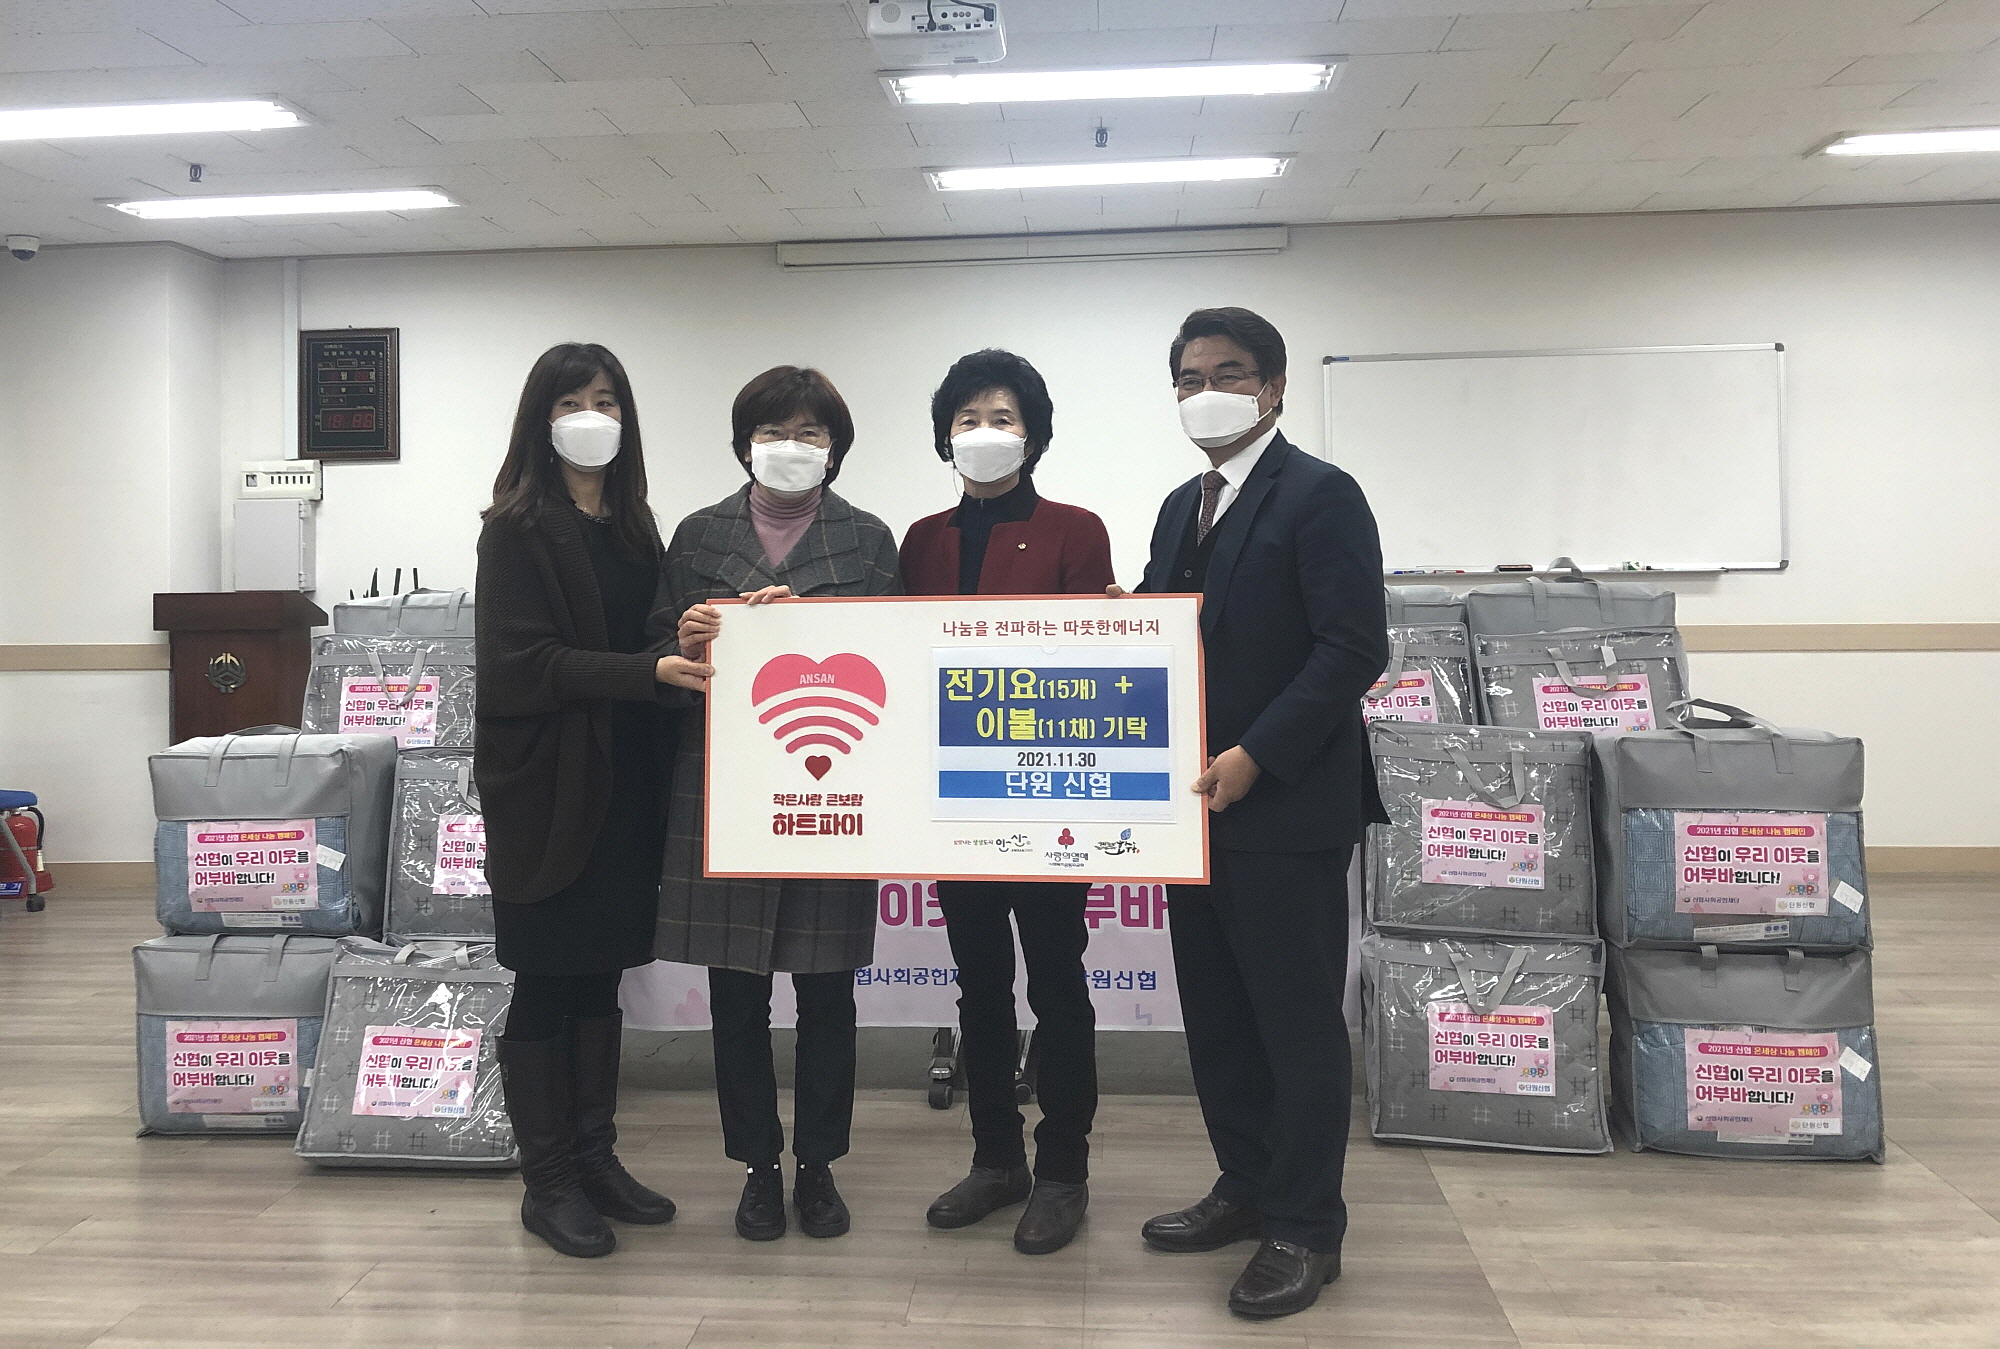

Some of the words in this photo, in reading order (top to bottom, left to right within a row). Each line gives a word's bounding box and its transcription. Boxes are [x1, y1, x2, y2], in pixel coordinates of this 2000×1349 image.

[943, 621, 989, 636] 나눔을
[995, 620, 1057, 636] 전파하는
[1063, 619, 1160, 636] 따뜻한에너지
[800, 673, 835, 684] ANSAN
[946, 669, 1097, 701] 전기요(15개)
[1114, 676, 1133, 694] +
[345, 700, 375, 711] 신협이
[1396, 695, 1430, 708] 이웃을
[1542, 700, 1578, 713] 신협이
[1581, 699, 1607, 712] 우리
[1610, 698, 1648, 710] 이웃을
[344, 715, 406, 727] 어부바합니다!
[976, 707, 1095, 740] 이불(11채)
[1103, 716, 1147, 740] 기탁
[1544, 716, 1618, 728] 어부바합니다!
[1017, 751, 1096, 767] 2021.11.30
[1005, 772, 1052, 797] 단원
[1063, 773, 1111, 798] 신협
[773, 793, 822, 806] 작은사랑
[827, 793, 863, 806] 큰보람
[1438, 810, 1459, 818] 2021년
[772, 813, 863, 836] 하트파이
[1696, 827, 1721, 835] 2021년
[1724, 827, 1739, 835] 신협
[204, 834, 225, 842] 2021년
[1427, 826, 1466, 840] 신협이
[1469, 828, 1496, 842] 우리
[1501, 829, 1539, 844] 이웃을
[442, 841, 475, 852] 신협이
[1427, 844, 1506, 860] 어부바합니다!
[194, 852, 232, 867] 신협이
[236, 850, 264, 865] 우리
[268, 850, 309, 865] 이웃을
[1044, 851, 1088, 863] 사랑의열매
[1684, 846, 1730, 862] 신협이
[1735, 847, 1768, 863] 우리
[1774, 847, 1819, 863] 이웃을
[194, 871, 274, 885] 어부바합니다!
[1684, 867, 1780, 884] 어부바합니다!
[1083, 969, 1156, 990] 원신협
[1434, 1031, 1473, 1046] 신협이
[1477, 1033, 1505, 1047] 우리
[1510, 1034, 1549, 1049] 이웃을
[1434, 1050, 1515, 1066] 어부바합니다!
[1708, 1045, 1733, 1053] 2021년
[1735, 1046, 1751, 1054] 신협
[1753, 1047, 1778, 1055] 온세상
[1780, 1048, 1795, 1056] 나눔
[173, 1053, 212, 1067] 신협이
[216, 1052, 243, 1066] 우리
[249, 1052, 290, 1066] 이웃을
[366, 1055, 402, 1068] 신협이
[405, 1056, 432, 1070] 우리
[173, 1072, 254, 1086] 어부바합니다!
[1695, 1064, 1743, 1081] 신협이
[1748, 1066, 1781, 1083] 우리
[1787, 1067, 1834, 1083] 이웃을
[1695, 1085, 1793, 1103] 어부바합니다!
